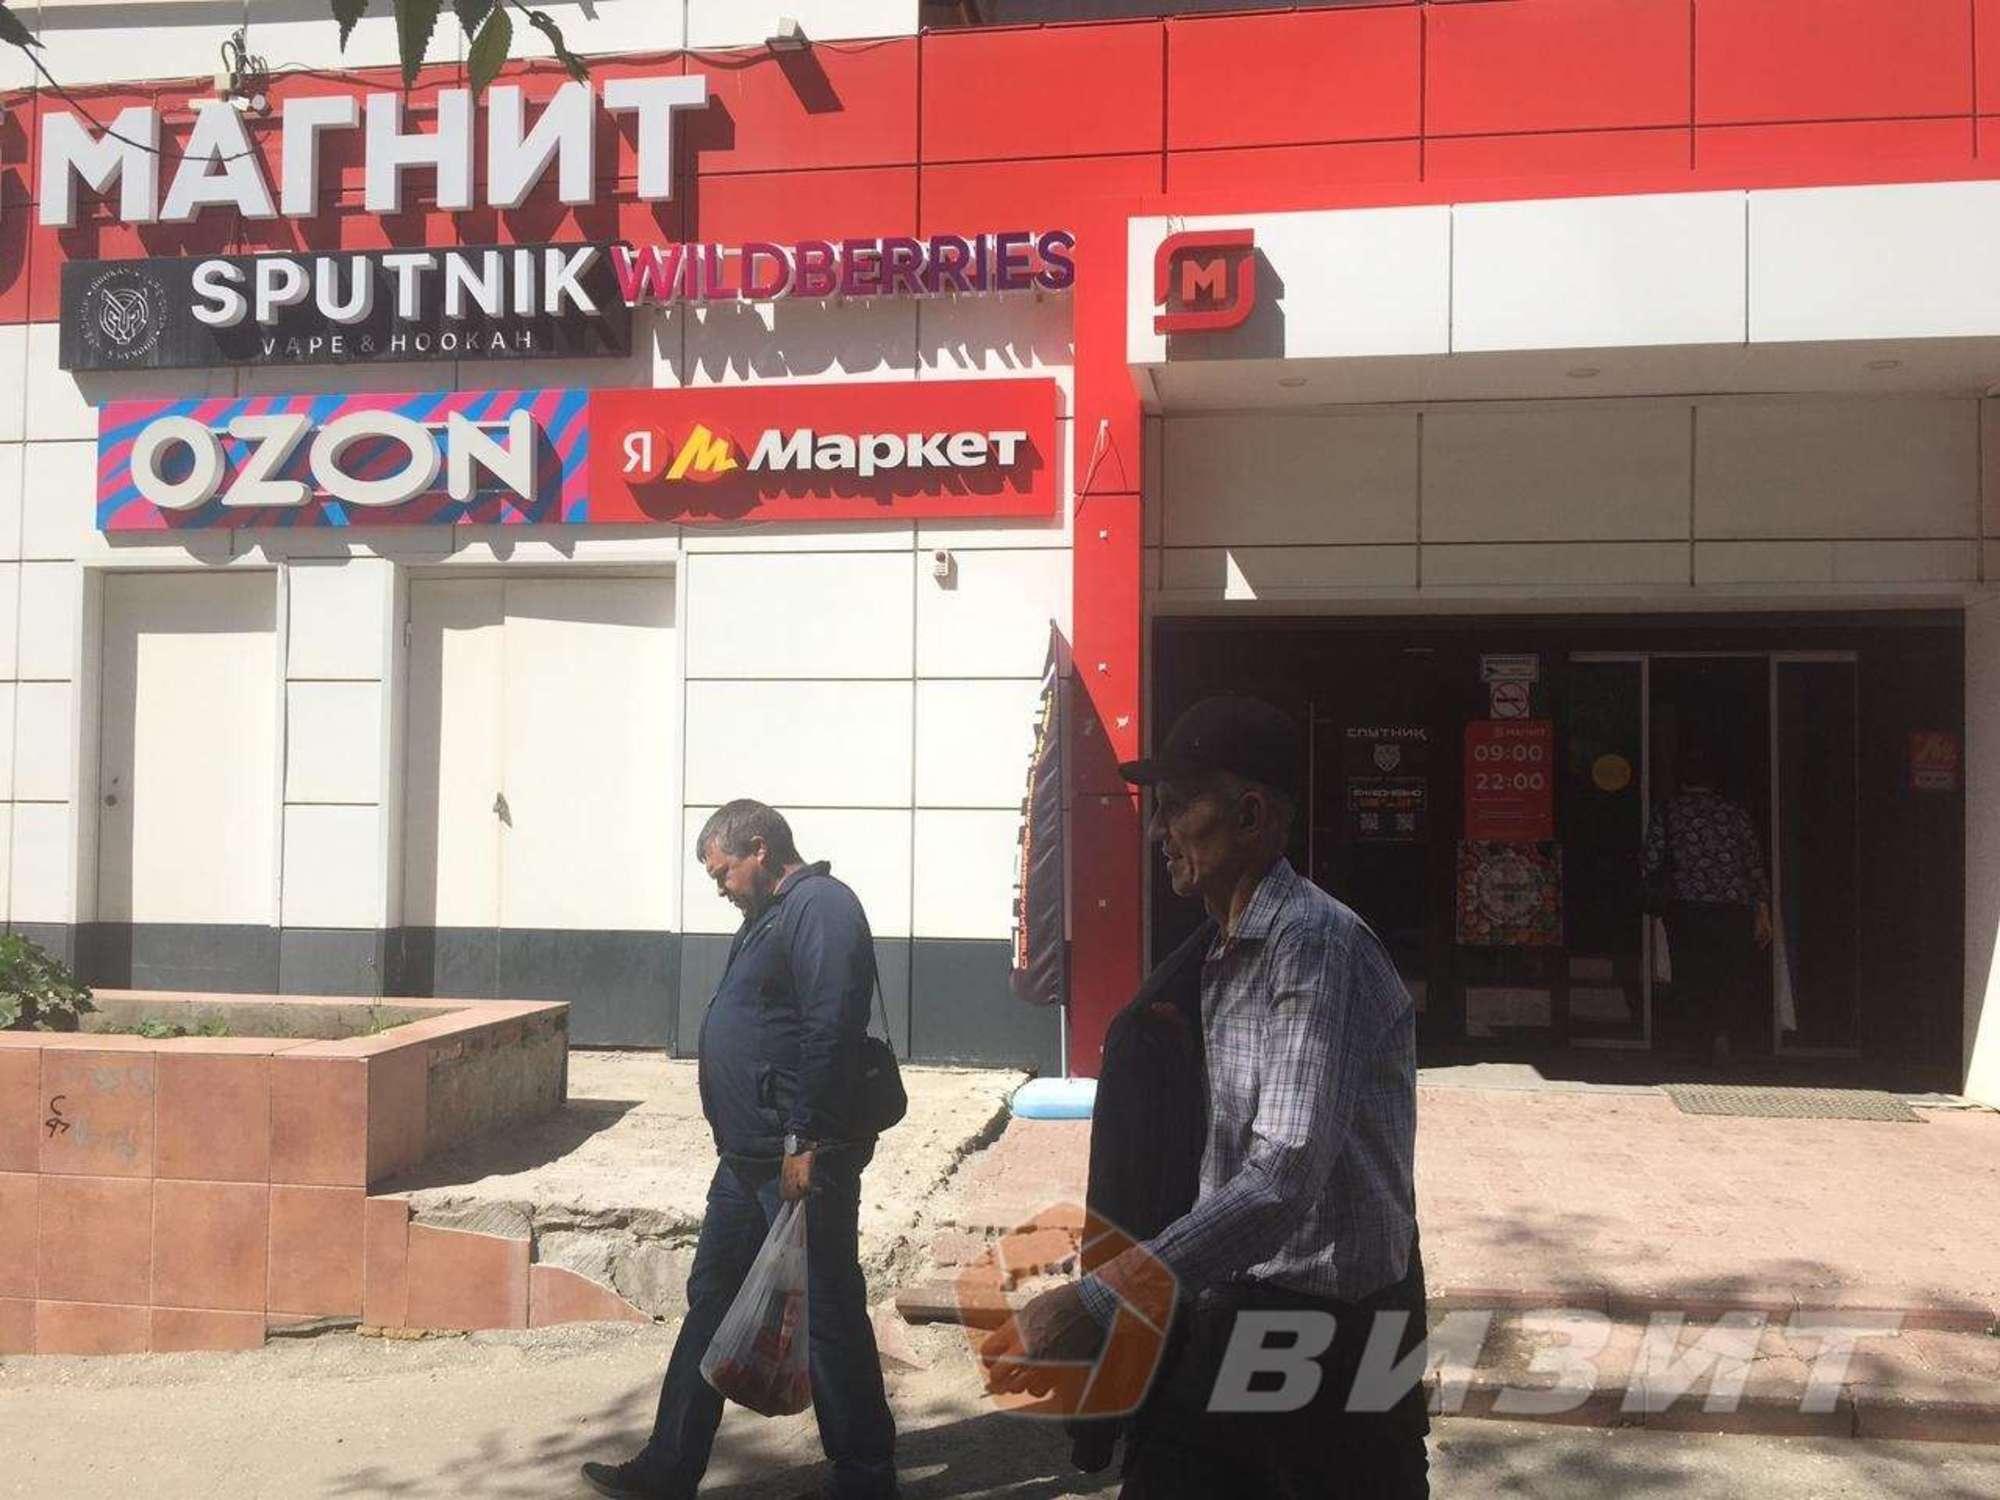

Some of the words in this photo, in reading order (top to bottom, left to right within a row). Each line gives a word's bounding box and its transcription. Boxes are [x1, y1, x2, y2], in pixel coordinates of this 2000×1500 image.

[39, 75, 707, 226] МАГНИТ
[191, 247, 604, 326] SPUTNIK
[611, 232, 1075, 303] WILDBERRIES
[262, 335, 344, 355] VAPE
[360, 334, 375, 351] &
[391, 330, 531, 352] HOOKAH
[131, 409, 537, 508] OZON
[619, 431, 652, 473] Я
[747, 428, 1027, 477] Маркет
[1474, 744, 1543, 762] 09:00
[1475, 772, 1544, 791] 22:00
